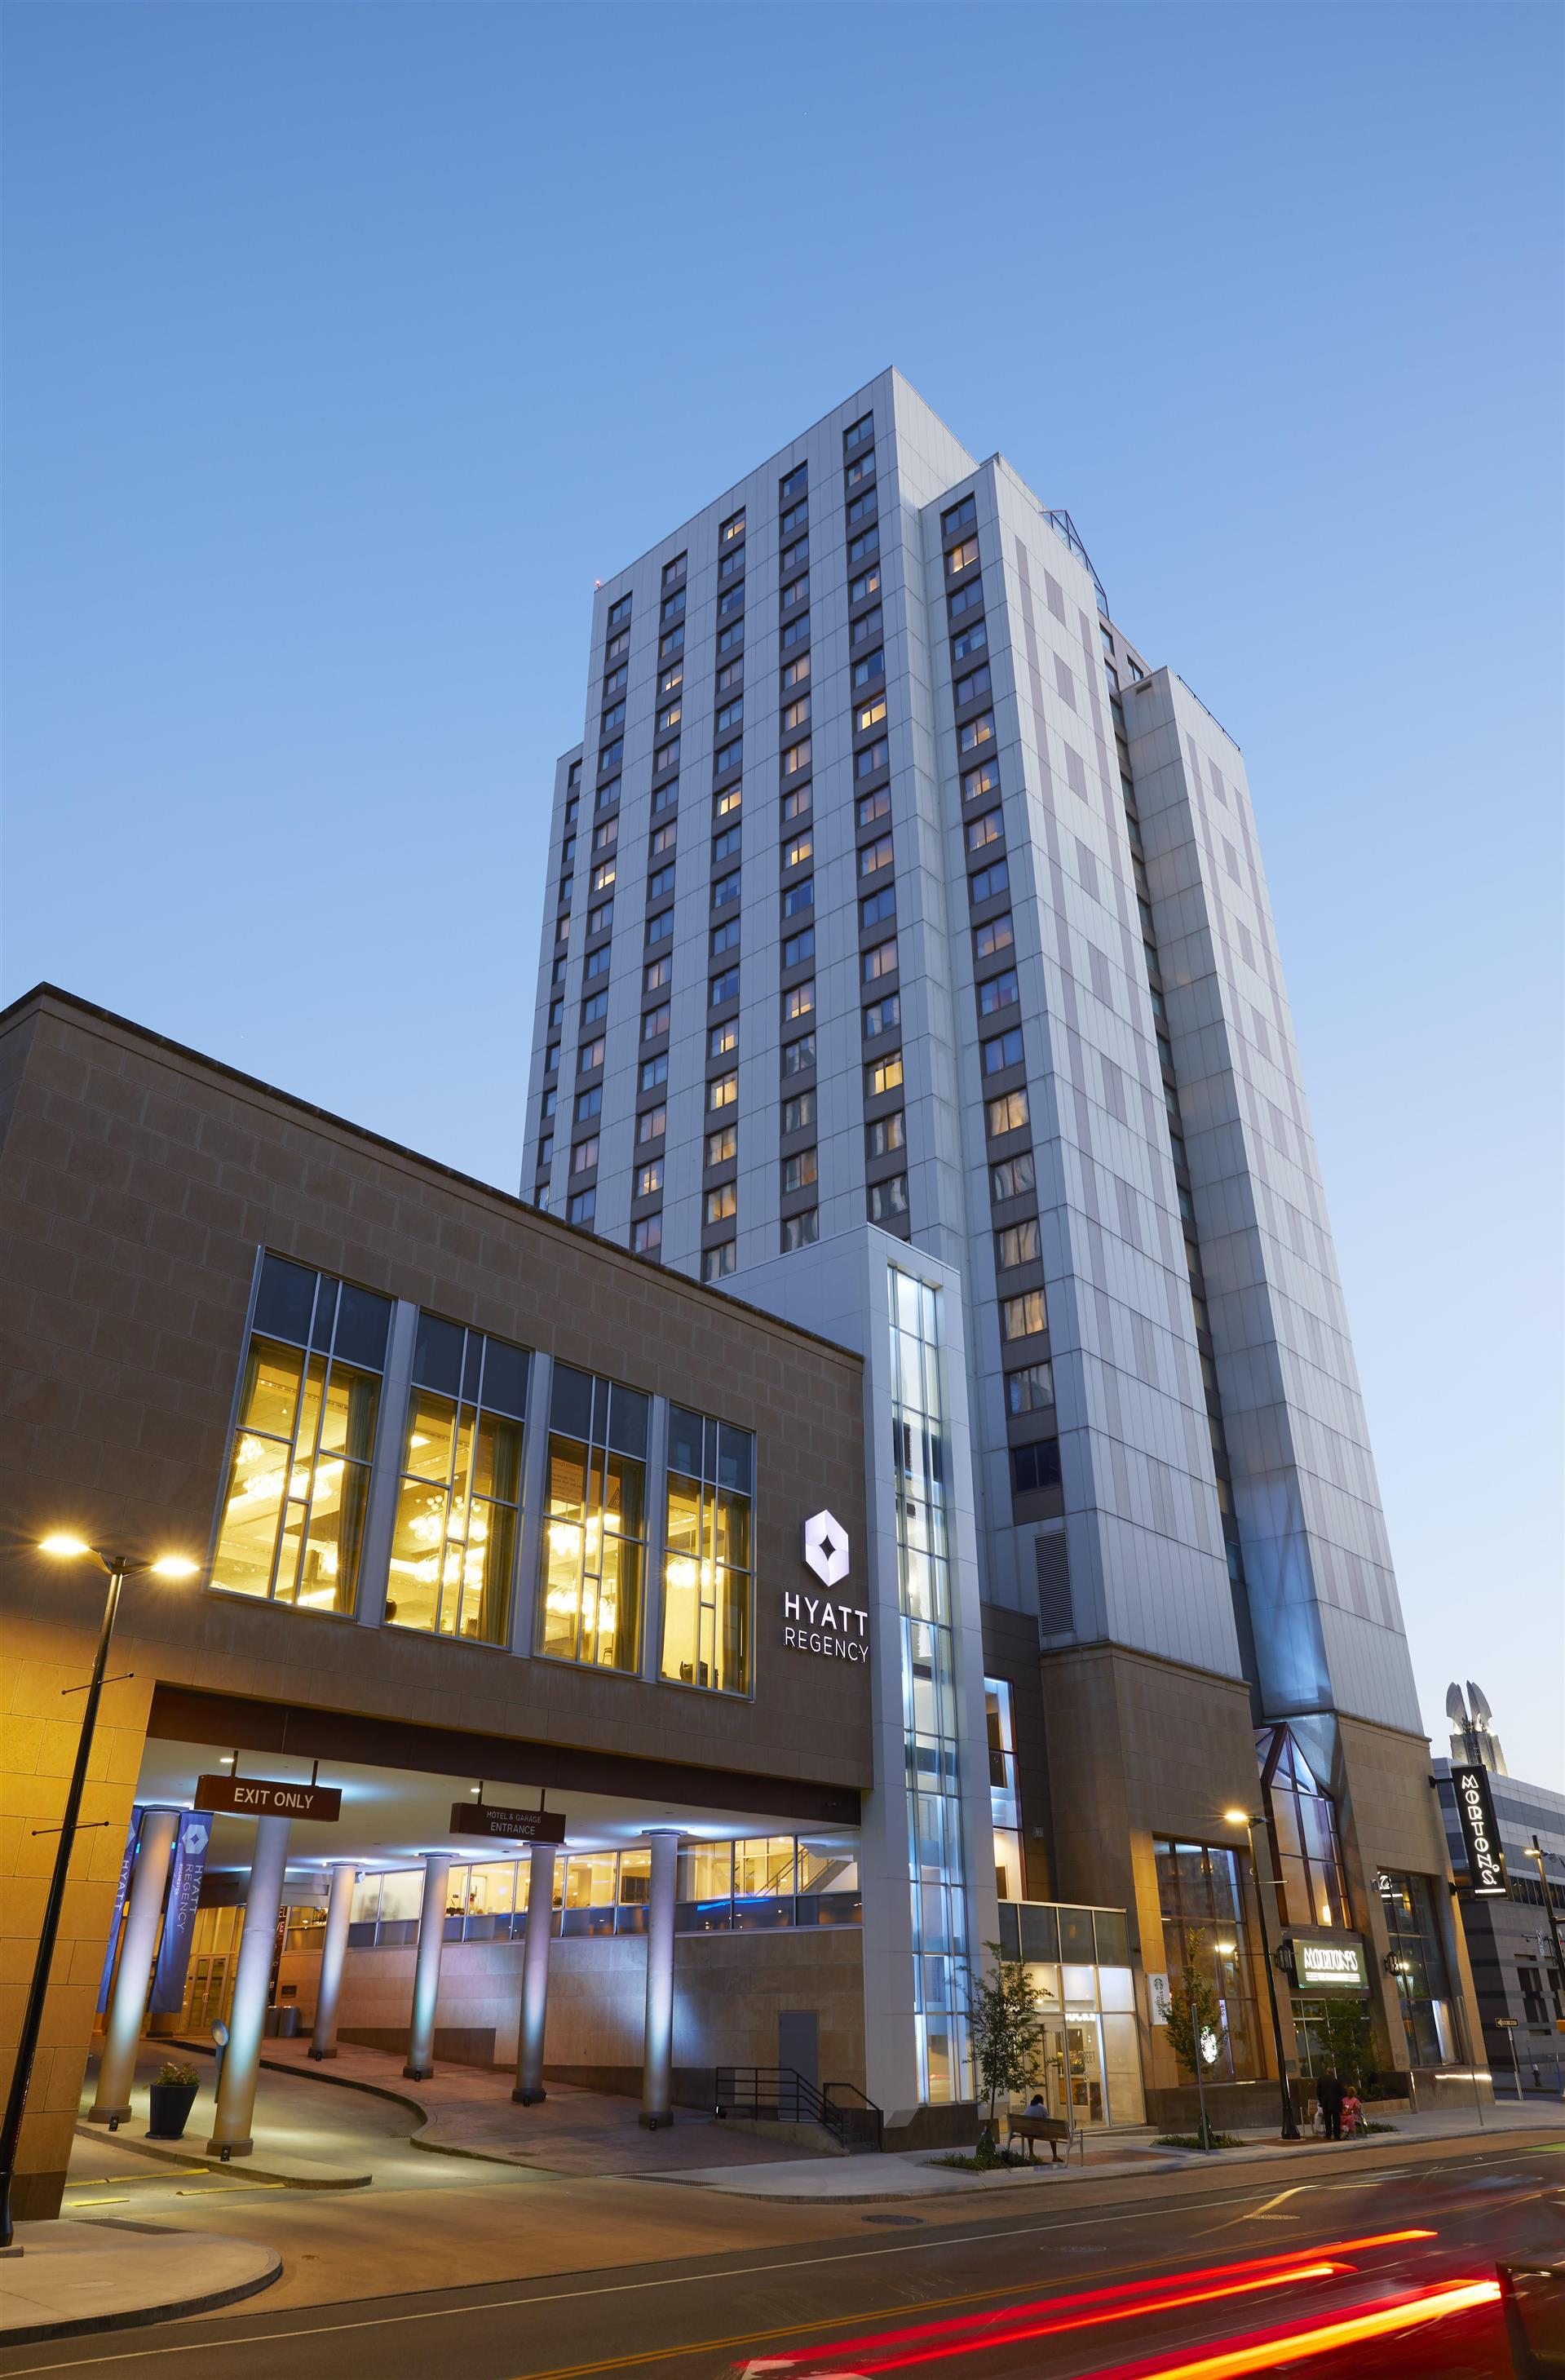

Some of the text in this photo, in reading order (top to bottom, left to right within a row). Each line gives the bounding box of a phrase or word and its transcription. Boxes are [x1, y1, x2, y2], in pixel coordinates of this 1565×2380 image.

[785, 1591, 869, 1637] HYATT
[784, 1626, 869, 1664] REGENCY
[233, 1787, 314, 1810] EXIT ONLY
[486, 1811, 508, 1820] HOTEL
[515, 1814, 542, 1824] GARAGE
[490, 1821, 536, 1835] ENTRANCE
[114, 1859, 130, 1912] HYATT
[176, 1864, 194, 1934] REGENCY
[189, 1865, 204, 1915] HYATT
